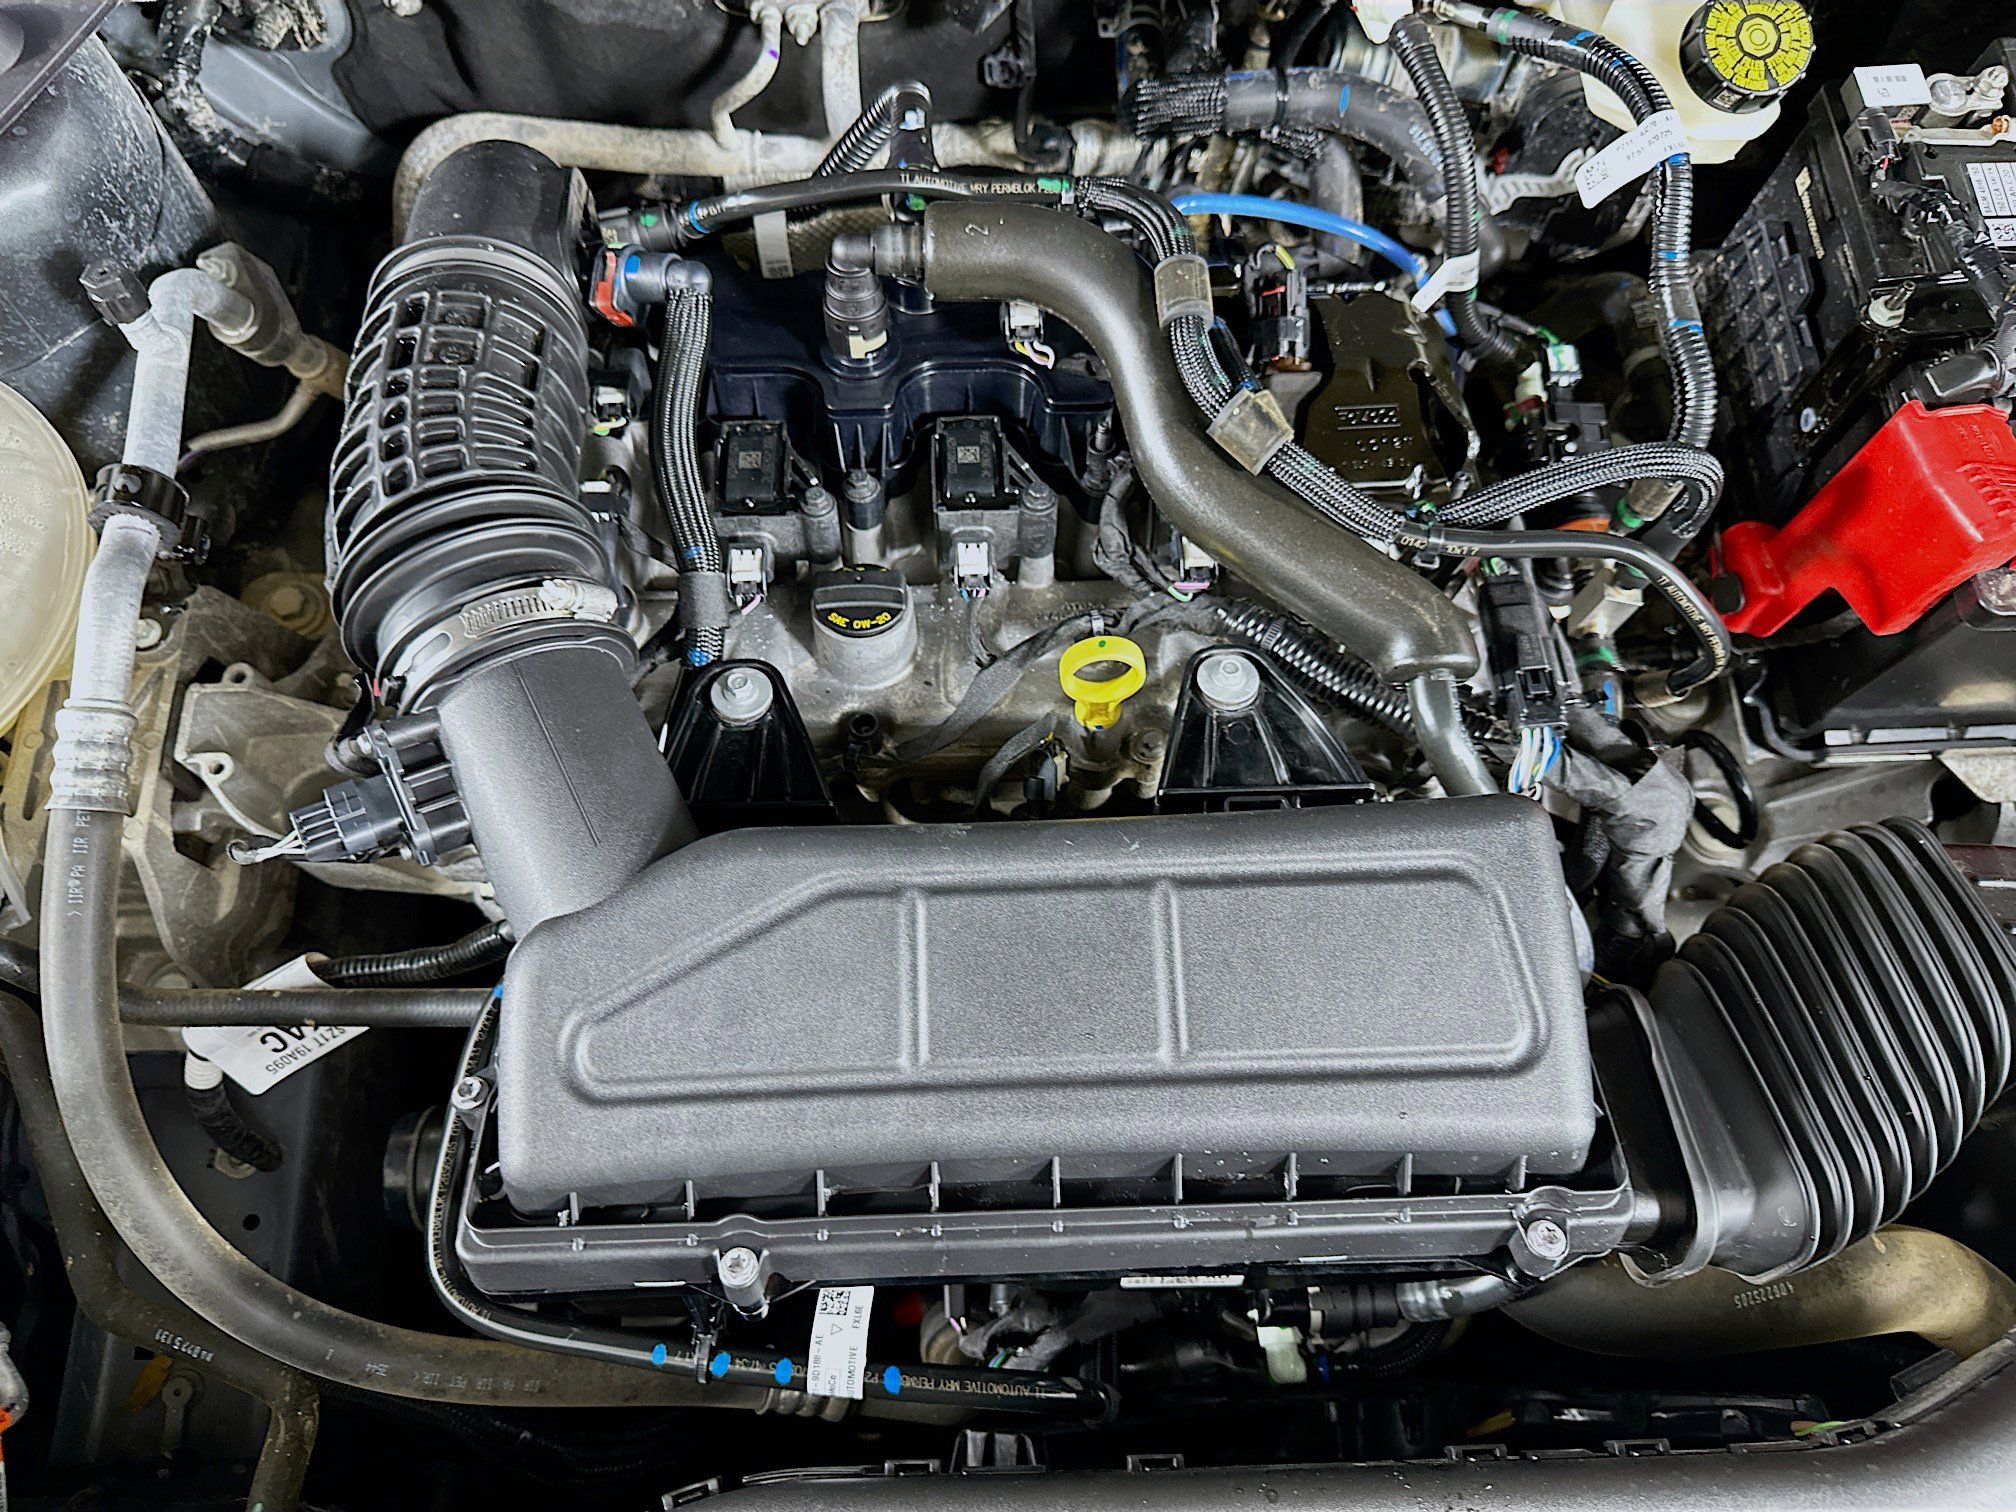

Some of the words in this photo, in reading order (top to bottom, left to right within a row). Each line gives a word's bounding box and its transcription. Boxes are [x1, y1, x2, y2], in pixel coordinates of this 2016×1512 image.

[914, 174, 967, 194] AUTOMOTIVE
[827, 612, 850, 628] SAE
[265, 1044, 312, 1075] 19A095
[965, 1379, 1032, 1397] AUTOMOTIVE
